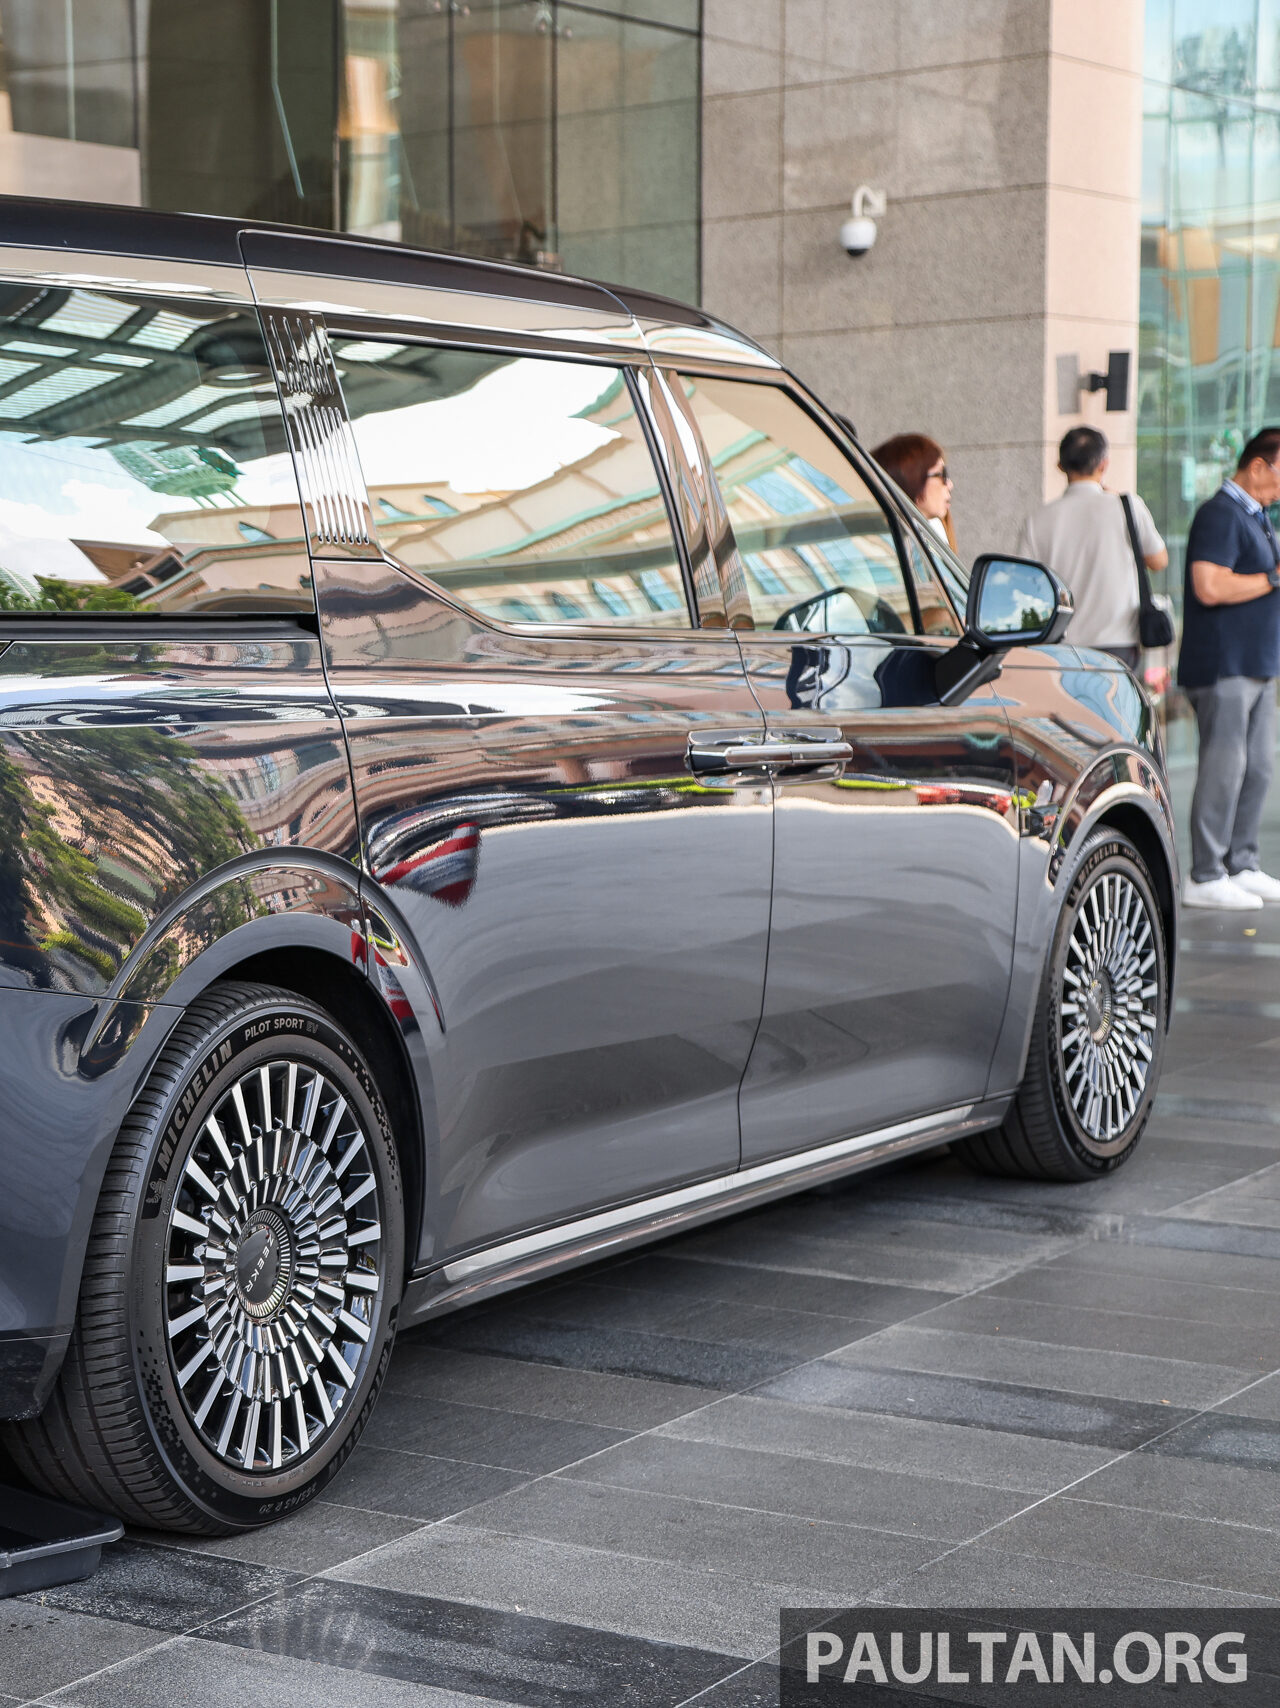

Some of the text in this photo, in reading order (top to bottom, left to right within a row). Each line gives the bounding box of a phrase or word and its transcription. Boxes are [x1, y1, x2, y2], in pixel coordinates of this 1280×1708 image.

[1078, 843, 1119, 887] MICHELIN
[244, 1018, 319, 1041] PILOT SPORT EV
[157, 1039, 233, 1172] MICHELIN
[244, 1234, 275, 1293] ZEEKR
